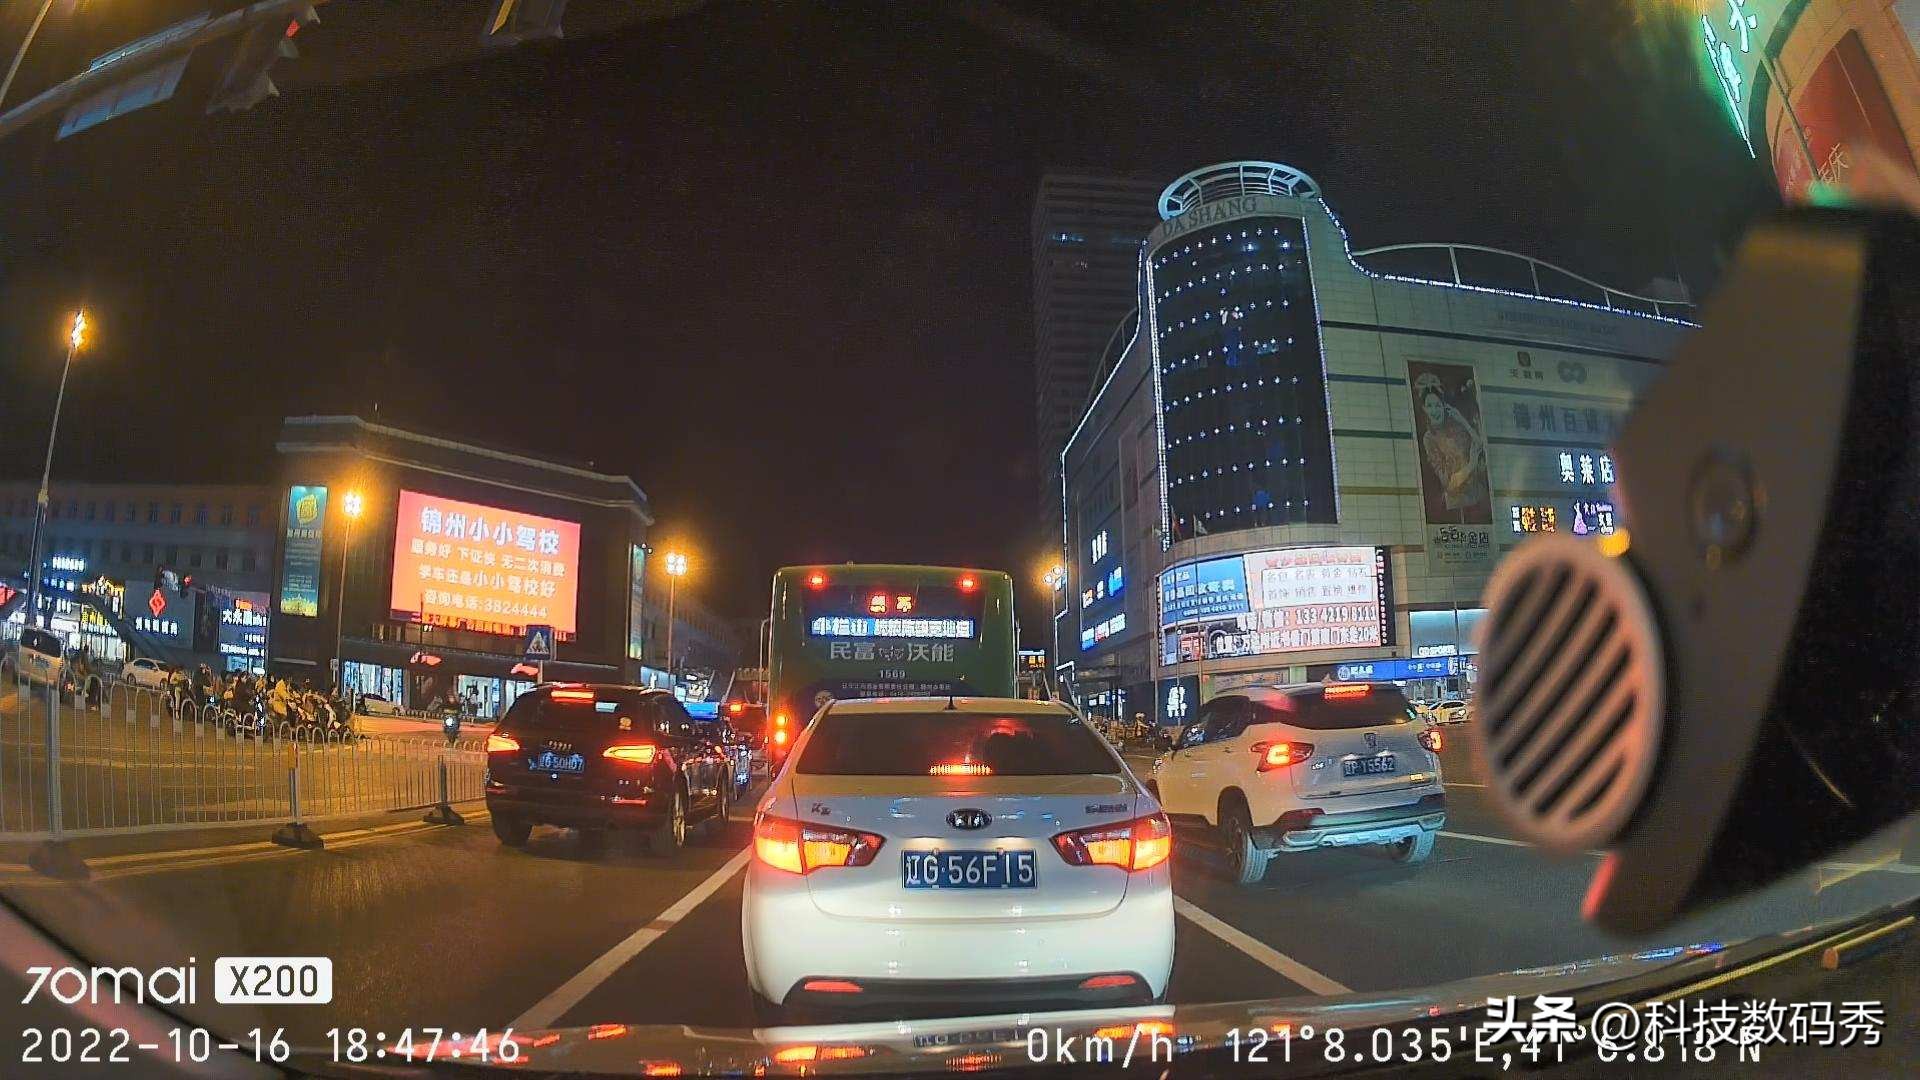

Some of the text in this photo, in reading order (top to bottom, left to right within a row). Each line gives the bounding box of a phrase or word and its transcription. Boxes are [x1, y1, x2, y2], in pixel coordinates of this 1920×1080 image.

[1162, 198, 1258, 237] DA SHANG
[1559, 452, 1615, 484] 奥莱店
[420, 506, 560, 555] 锦州小小驾校
[830, 642, 955, 662] 民富 沃能
